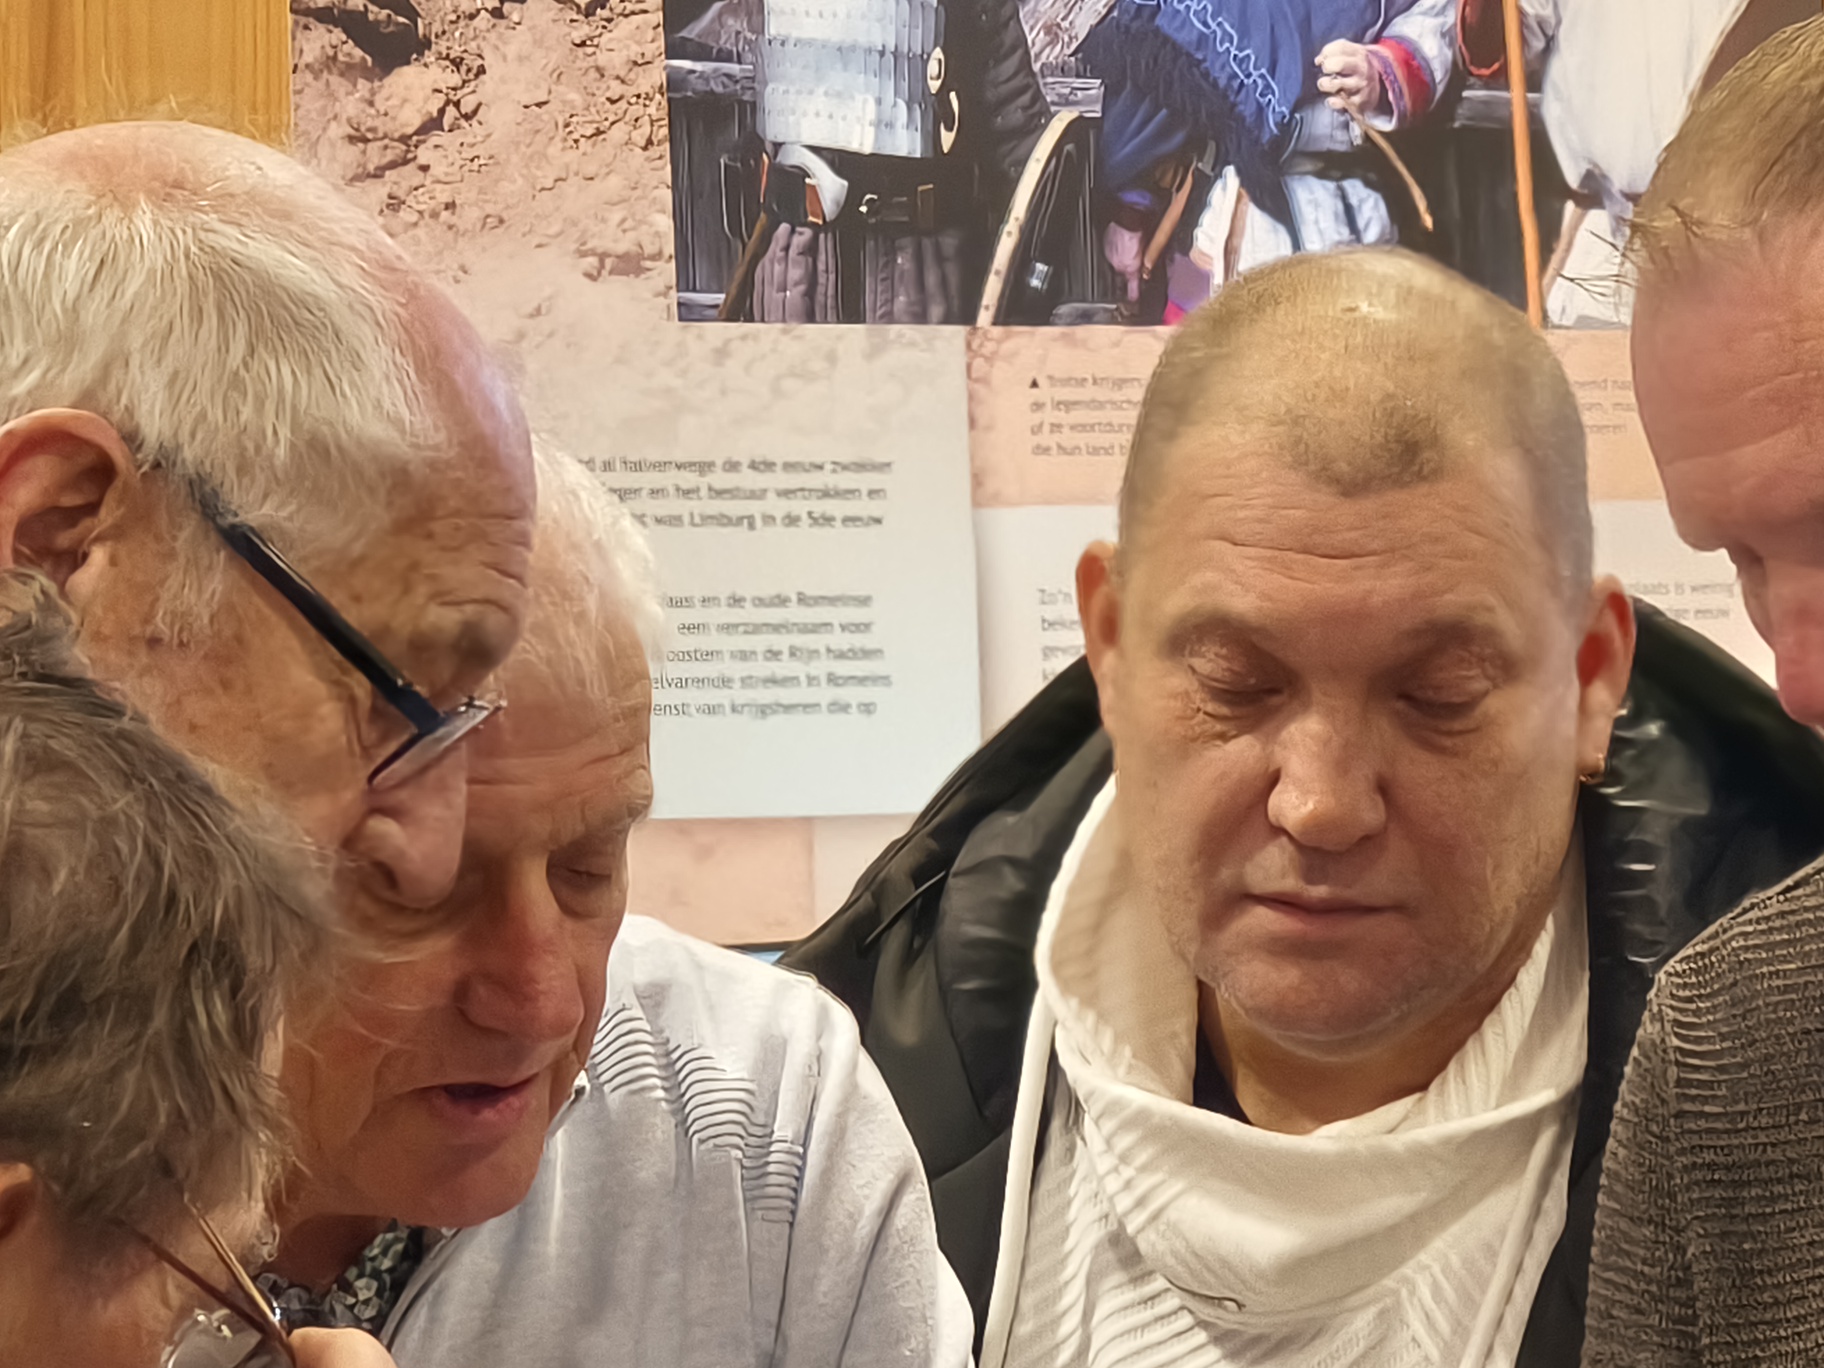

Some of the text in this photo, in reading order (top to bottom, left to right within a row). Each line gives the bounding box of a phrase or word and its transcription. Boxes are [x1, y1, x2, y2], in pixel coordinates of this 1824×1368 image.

[619, 456, 716, 478] halverwege
[721, 457, 743, 473] de
[674, 484, 703, 500] het
[866, 488, 887, 500] en
[653, 513, 684, 527] was
[689, 511, 757, 531] Limburg
[761, 514, 776, 527] in
[780, 511, 802, 527] de
[841, 514, 883, 527] eeuw
[725, 592, 747, 608] de
[752, 593, 792, 608] oude
[677, 622, 708, 635] een
[838, 622, 874, 635] voor
[762, 646, 784, 662] de
[652, 671, 734, 689] elvarende
